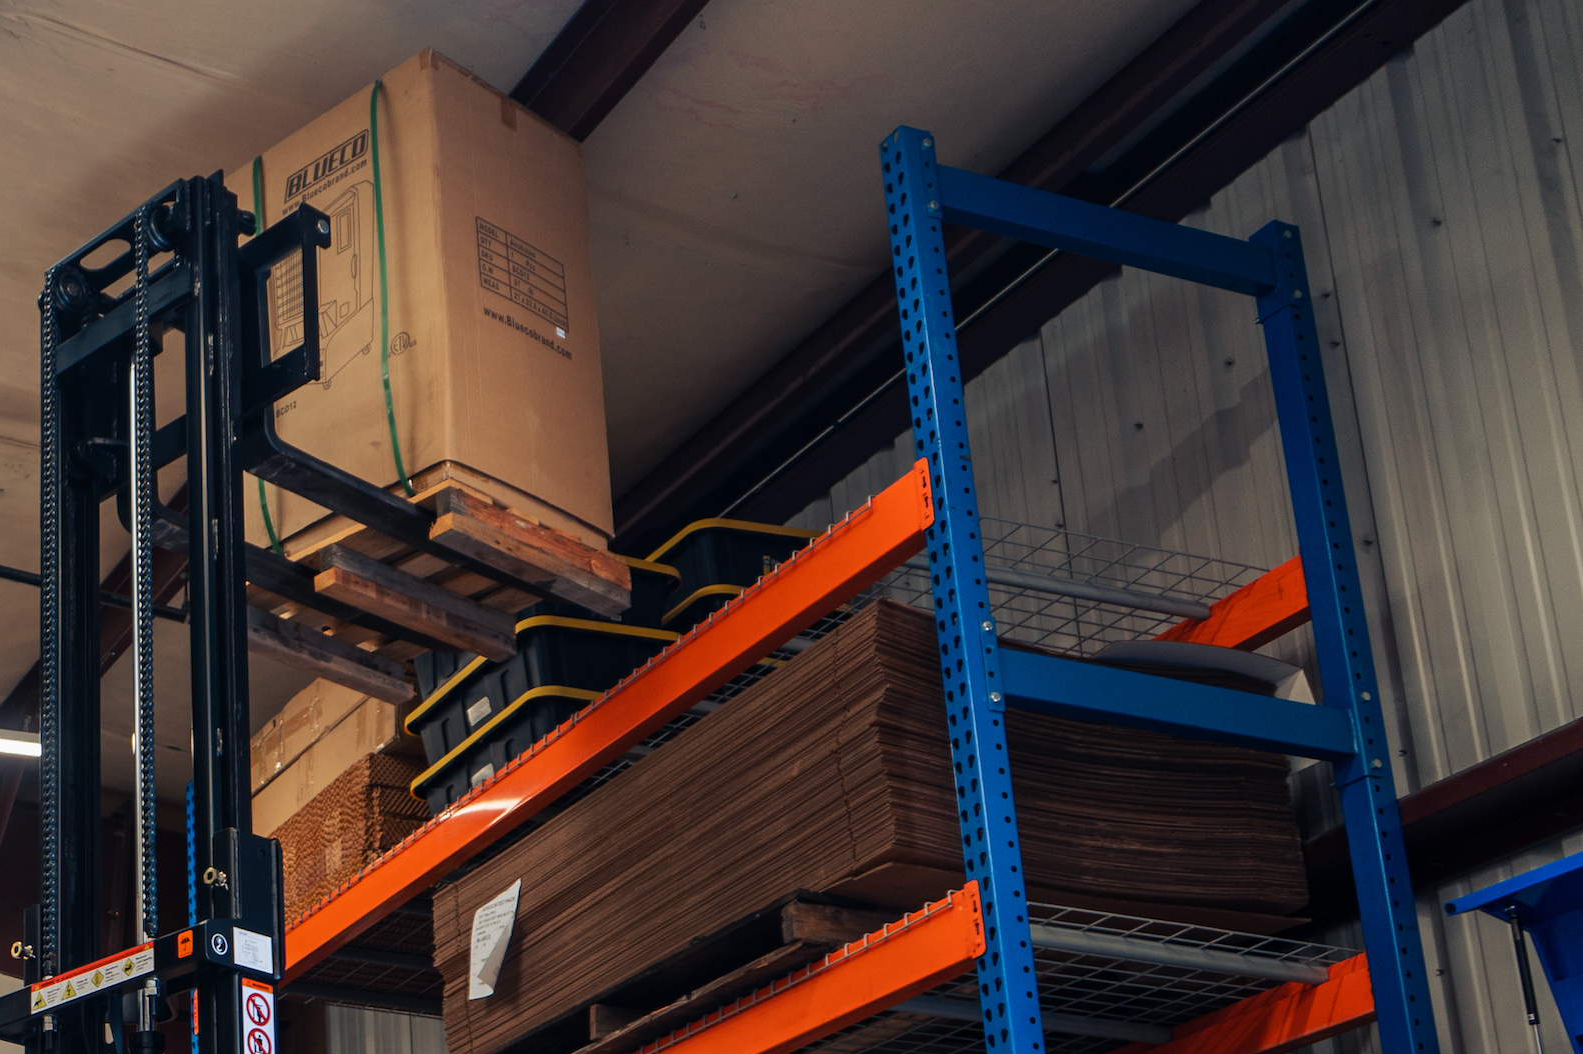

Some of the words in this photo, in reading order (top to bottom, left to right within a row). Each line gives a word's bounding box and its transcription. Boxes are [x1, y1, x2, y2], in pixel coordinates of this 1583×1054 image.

[285, 130, 368, 201] BLUECO
[479, 222, 499, 238] MODEL
[480, 236, 492, 247] QTY
[481, 250, 493, 261] SKU
[483, 277, 500, 290] MEAS
[483, 306, 573, 361] www.Bluecobrand.com
